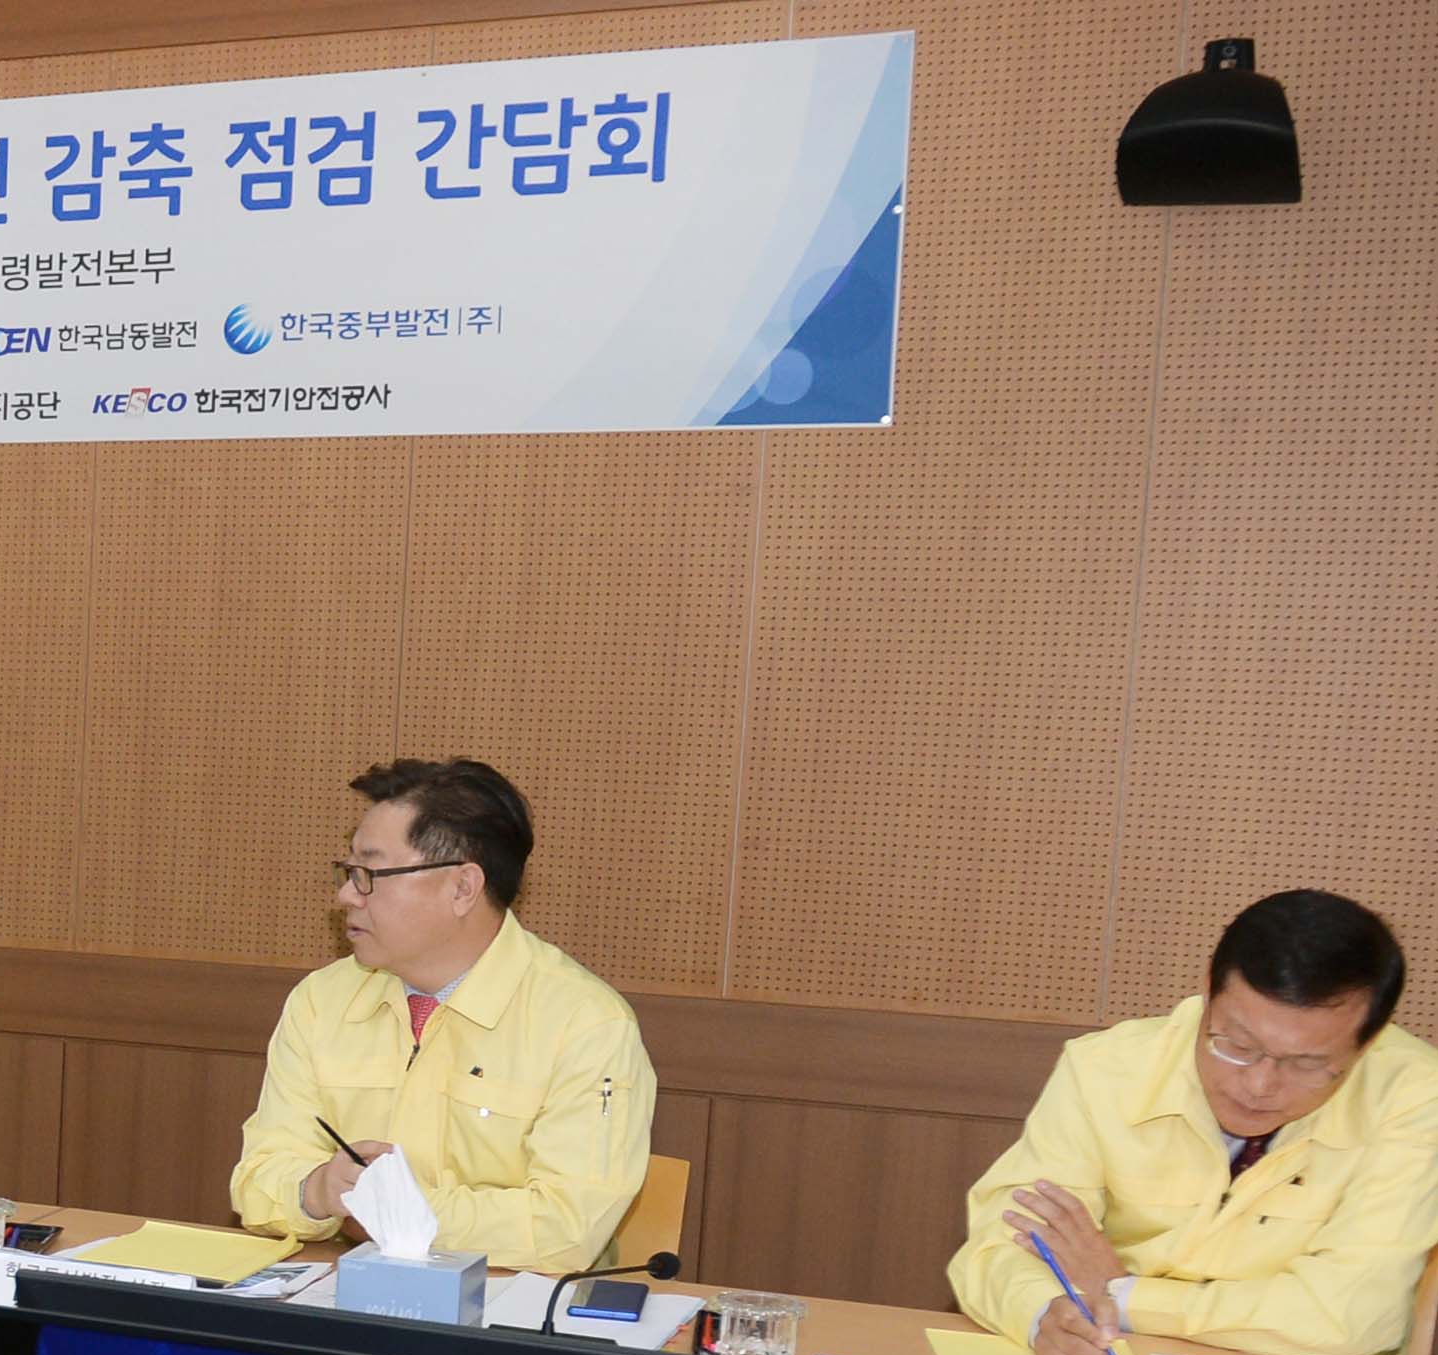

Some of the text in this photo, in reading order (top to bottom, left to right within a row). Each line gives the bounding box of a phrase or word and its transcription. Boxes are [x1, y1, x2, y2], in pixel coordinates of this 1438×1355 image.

[43, 122, 193, 222] 감축
[224, 110, 377, 212] 점검
[415, 91, 671, 200] 간담회
[58, 320, 198, 352] 한국남동발전
[280, 307, 450, 341] 한국중부발전
[92, 388, 188, 416] KESCO
[194, 384, 392, 414] 한국전기안전공사
